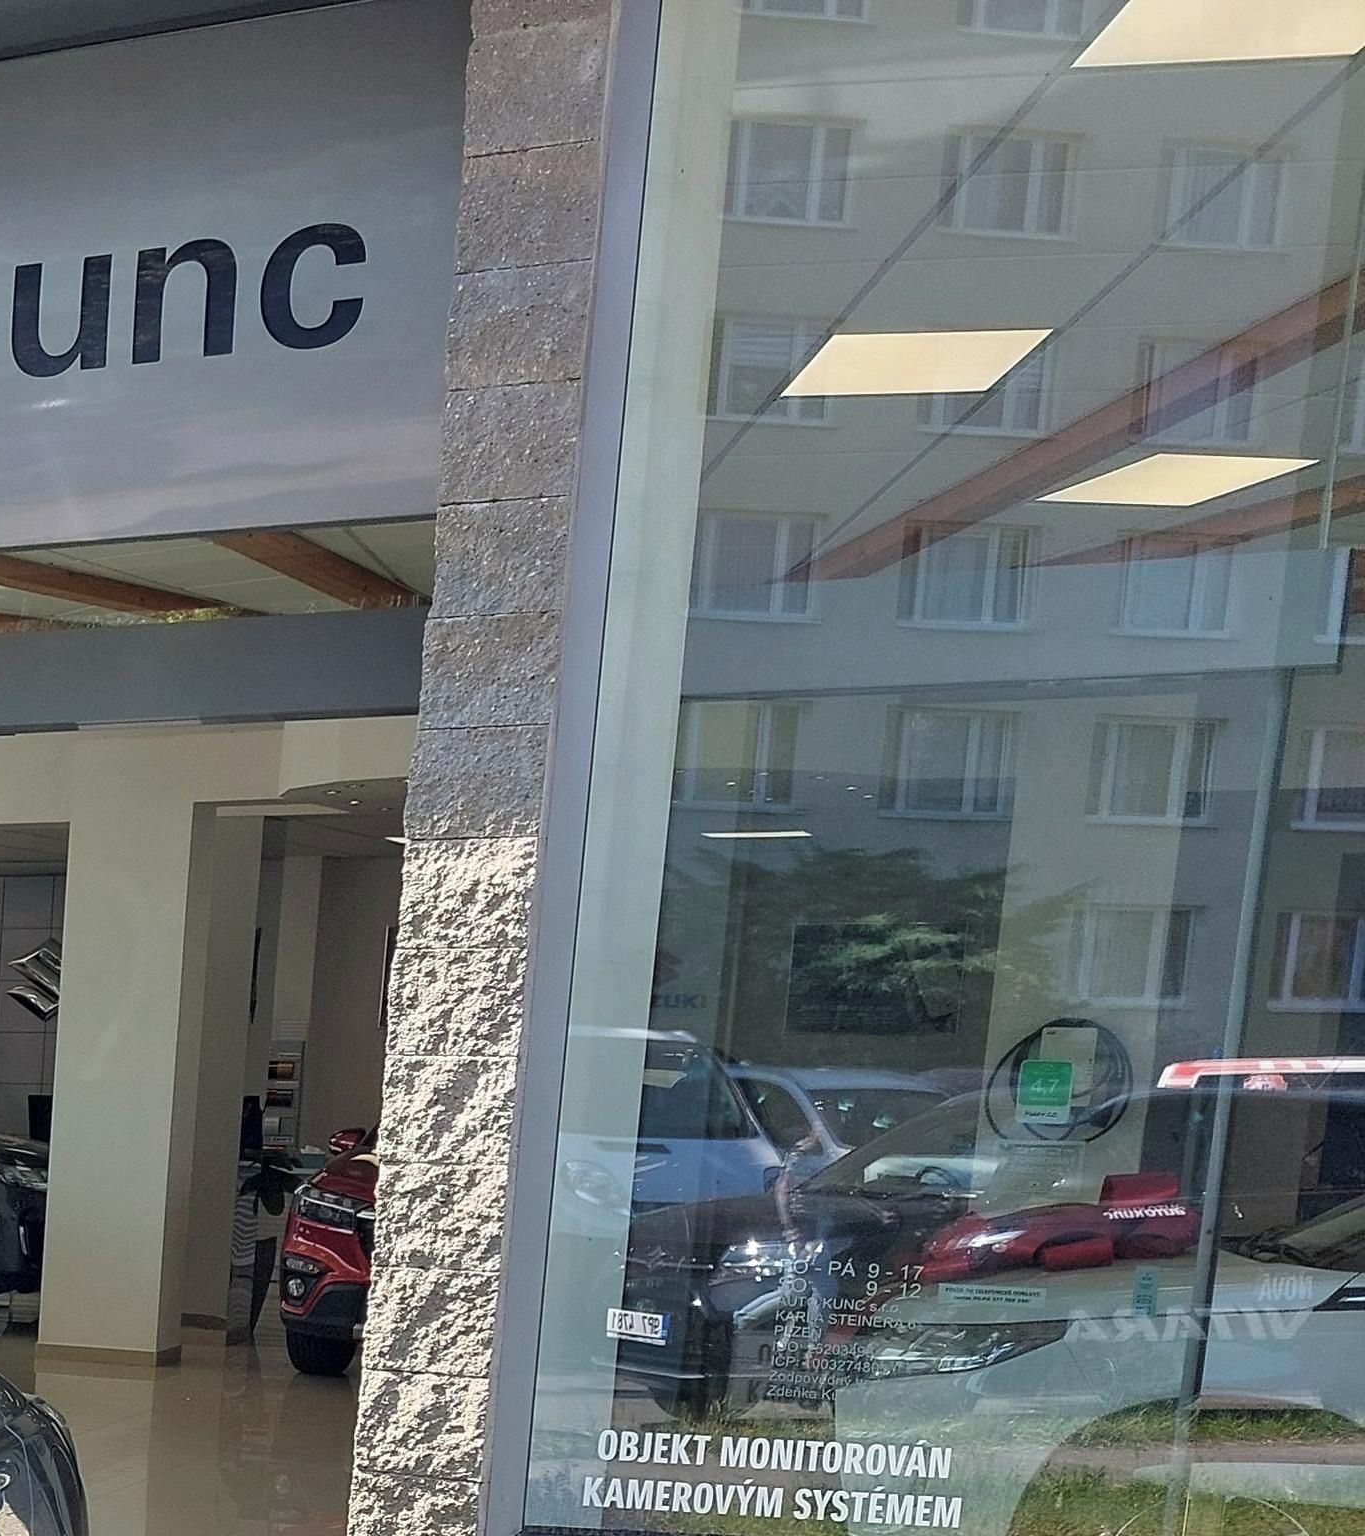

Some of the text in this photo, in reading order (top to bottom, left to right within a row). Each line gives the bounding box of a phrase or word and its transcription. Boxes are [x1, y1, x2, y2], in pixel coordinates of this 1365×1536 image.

[828, 1257, 856, 1278] PÁ
[867, 1262, 880, 1279] 9
[900, 1264, 925, 1281] 17
[865, 1280, 878, 1297] 9
[898, 1283, 922, 1299] 12
[823, 1298, 866, 1311] KUNC
[827, 1313, 905, 1330] STEINERA
[766, 1384, 818, 1400] Zdeňka
[596, 1428, 953, 1480] OBJEKT MONITOROVÁN
[580, 1475, 963, 1529] KAMEROVÝM SYSTÉMEM
